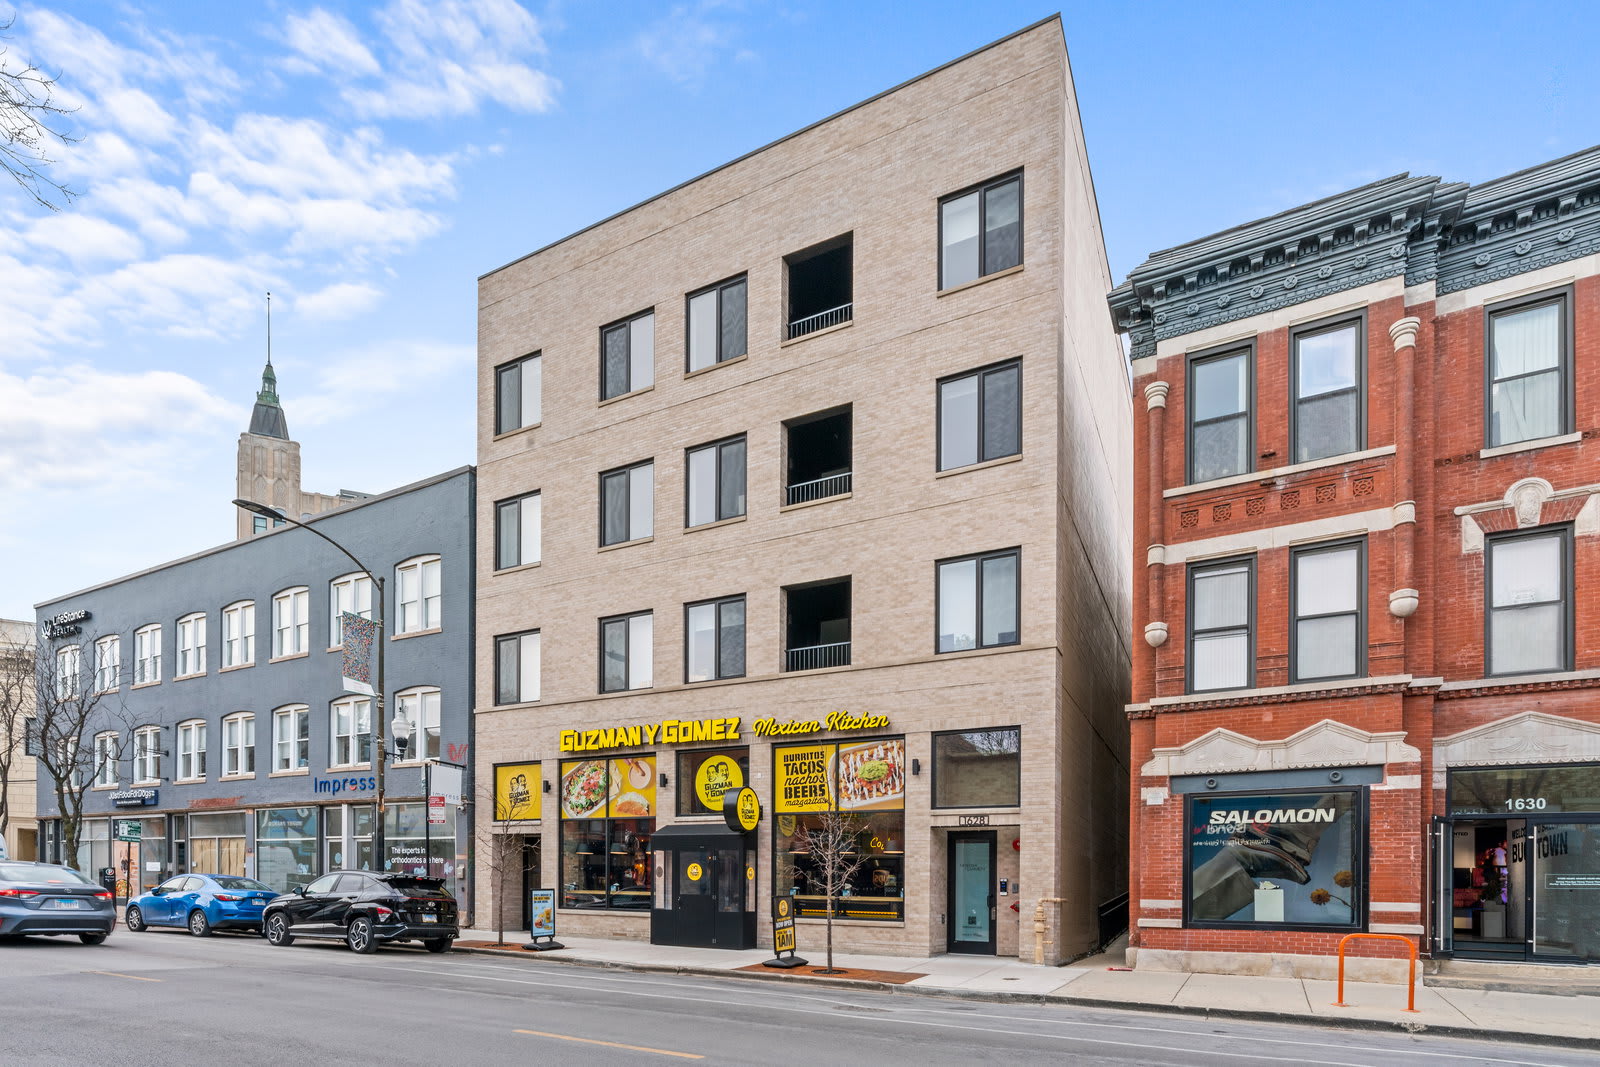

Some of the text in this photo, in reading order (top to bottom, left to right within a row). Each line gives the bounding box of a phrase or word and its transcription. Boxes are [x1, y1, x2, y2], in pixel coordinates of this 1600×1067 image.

[53, 609, 86, 626] LifeStance
[754, 710, 889, 737] Mexican Kitchen
[559, 717, 741, 752] GUZMAN Y GOMEZ
[783, 751, 825, 763] BURRITOS
[783, 760, 825, 776] TACOS
[314, 776, 376, 796] Impress
[704, 780, 733, 791] GUZMAN
[784, 772, 825, 787] nachos
[704, 790, 710, 799] Y
[784, 784, 826, 800] BEERS
[1504, 797, 1547, 810] 1630
[1209, 808, 1335, 824] SALOMON
[391, 846, 426, 856] The experts in
[391, 856, 422, 864] orthodontics
[432, 855, 444, 864] here
[777, 933, 793, 948] 1AM
